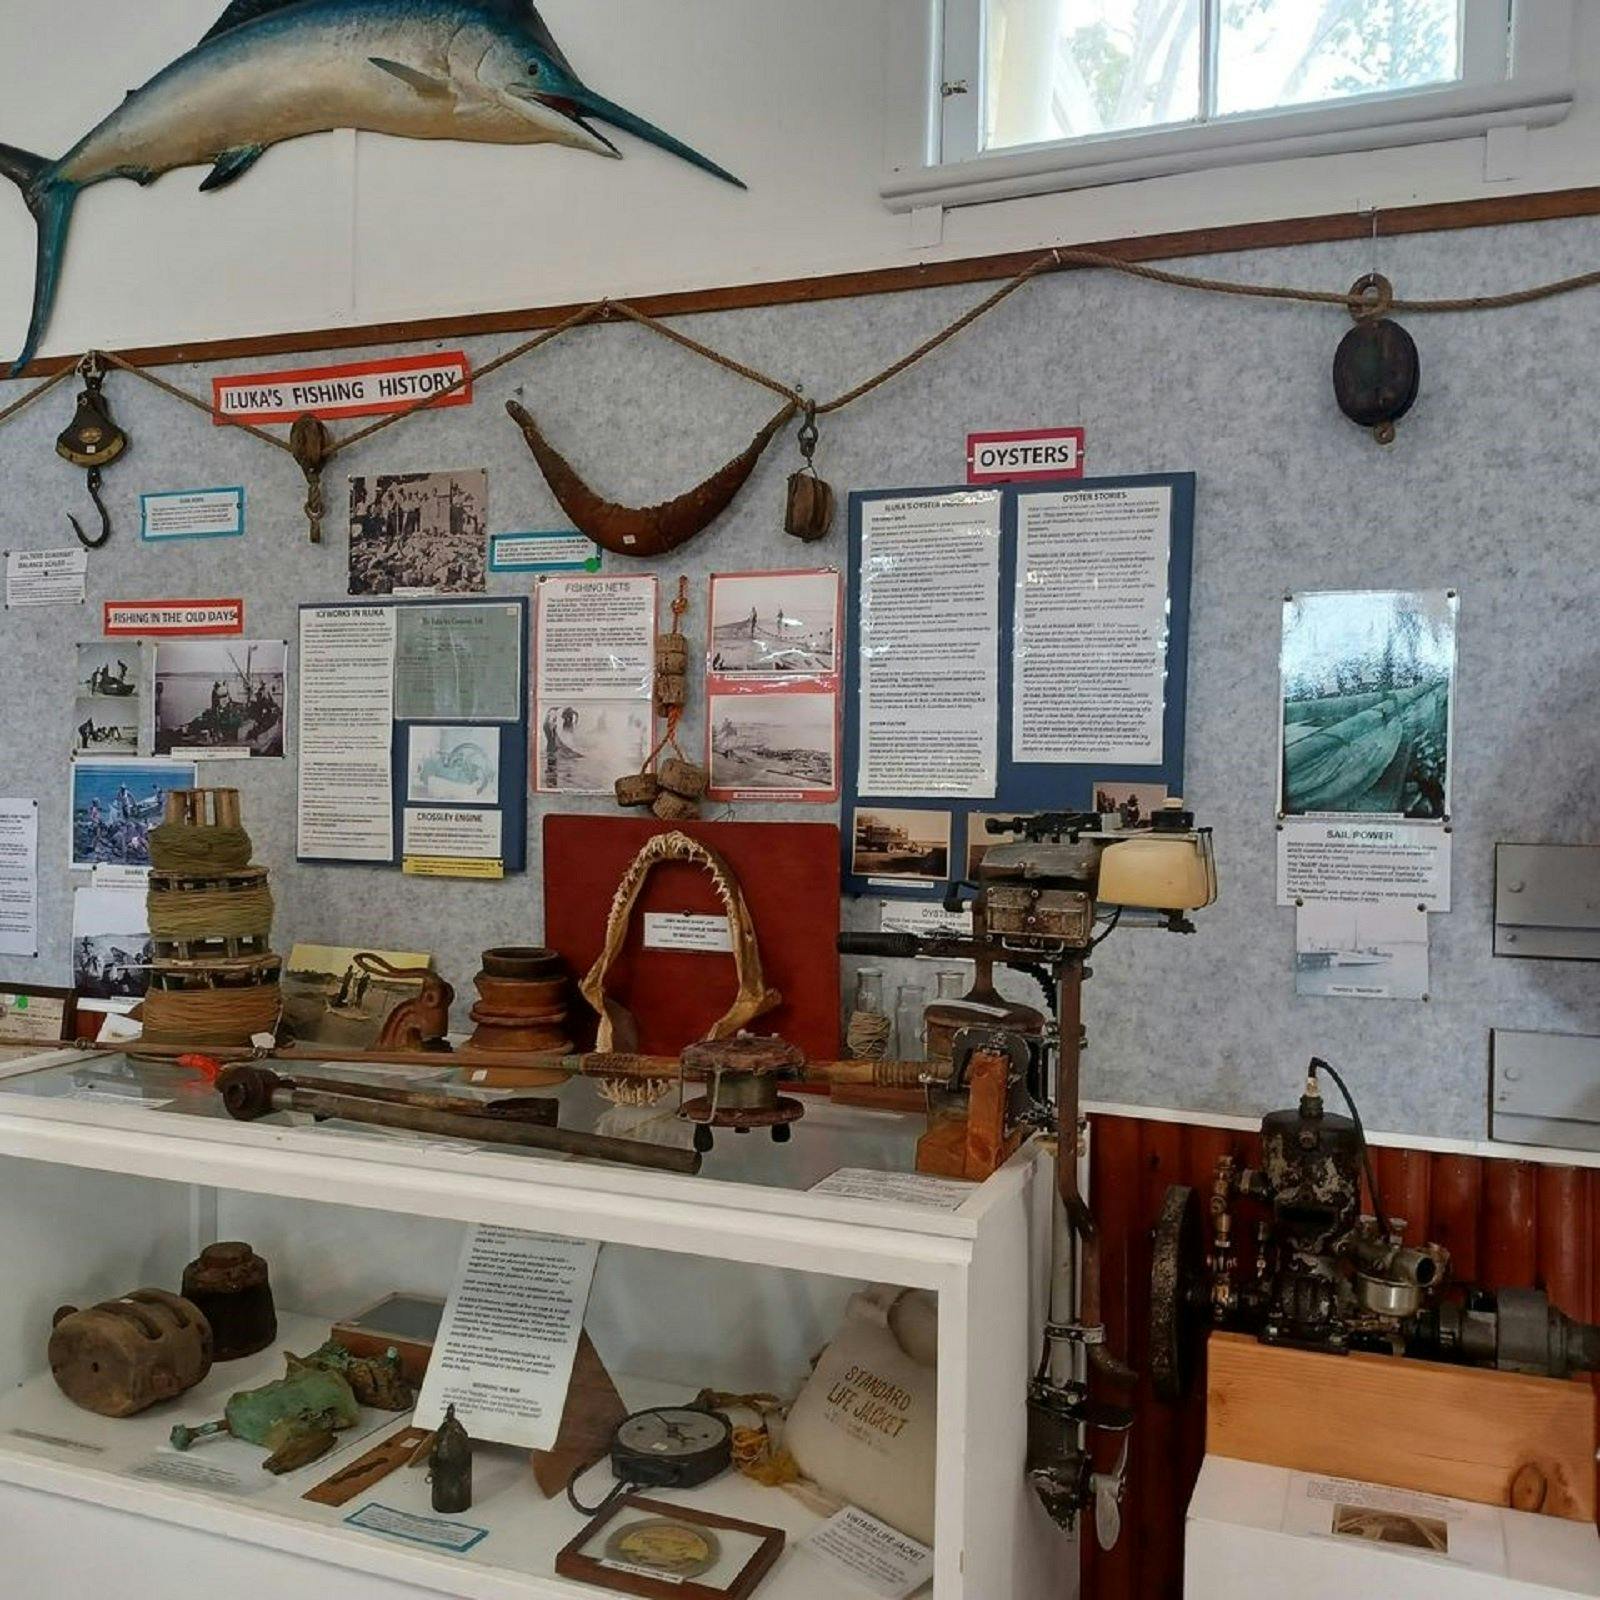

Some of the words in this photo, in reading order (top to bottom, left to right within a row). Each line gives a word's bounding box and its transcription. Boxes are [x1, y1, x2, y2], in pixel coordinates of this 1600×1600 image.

[225, 388, 283, 409] ILUKA'S
[292, 381, 364, 405] FISHING
[379, 371, 457, 397] HISTORY
[981, 445, 1069, 467] OYSTERS
[1062, 493, 1093, 502] OYSTER
[565, 582, 604, 592] FISHING
[605, 582, 631, 592] NETS
[113, 612, 149, 623] FISHING
[150, 612, 160, 623] IN
[161, 612, 182, 623] THE
[185, 611, 206, 622] OLD
[207, 610, 235, 621] DAYS
[352, 609, 360, 617] IN
[1327, 830, 1350, 840] SAIL
[1352, 830, 1393, 840] POWER
[845, 1366, 911, 1411] STANDARD
[827, 1382, 858, 1412] LIFE
[853, 1400, 909, 1438] JACKET
[846, 1512, 877, 1535] VINTAGE
[876, 1531, 896, 1543] LIFE
[895, 1541, 926, 1561] JACKET
